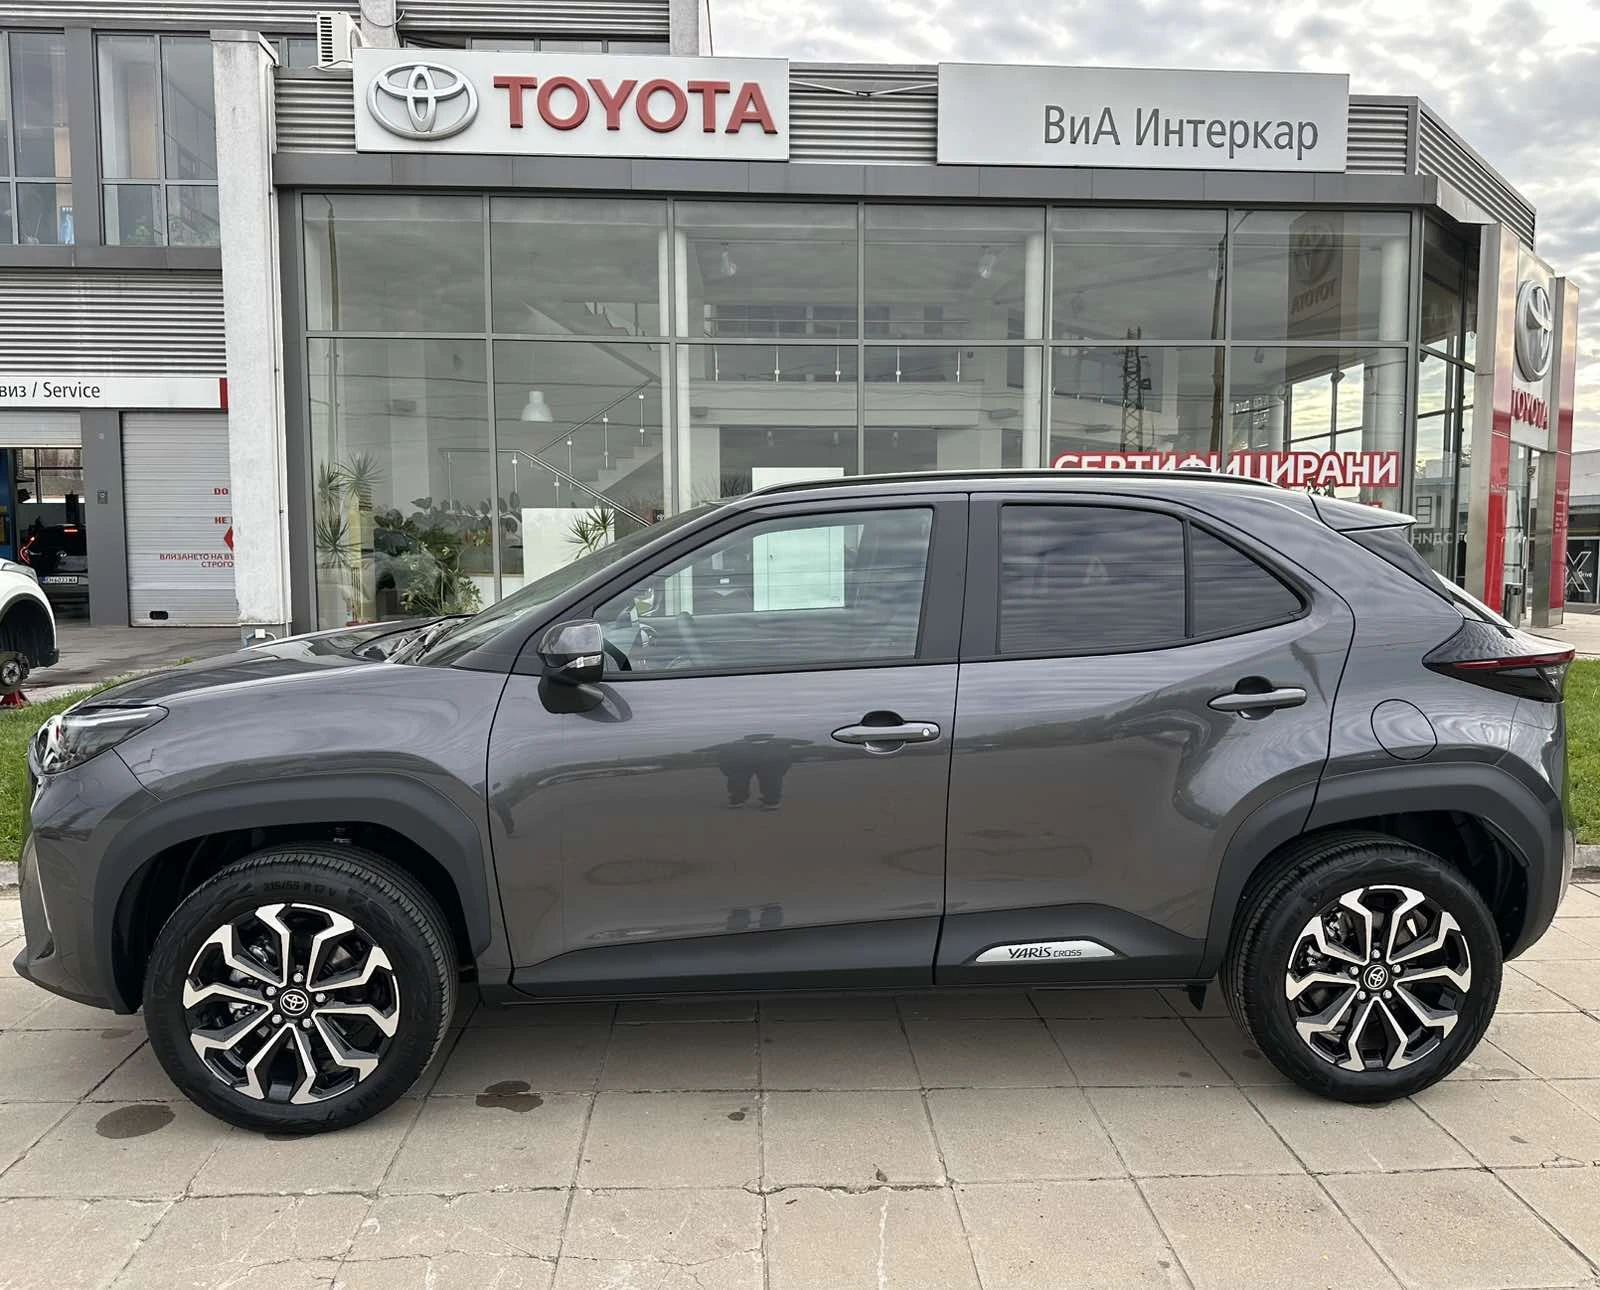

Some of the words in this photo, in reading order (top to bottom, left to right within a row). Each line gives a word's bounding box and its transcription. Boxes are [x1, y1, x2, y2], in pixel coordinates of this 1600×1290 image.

[493, 75, 778, 134] TOYOTA
[1043, 104, 1121, 145] ВиА
[1134, 107, 1319, 160] Интеркар
[43, 381, 101, 398] Service
[1511, 389, 1548, 430] TOYOTA
[1053, 949, 1082, 958] CROSS
